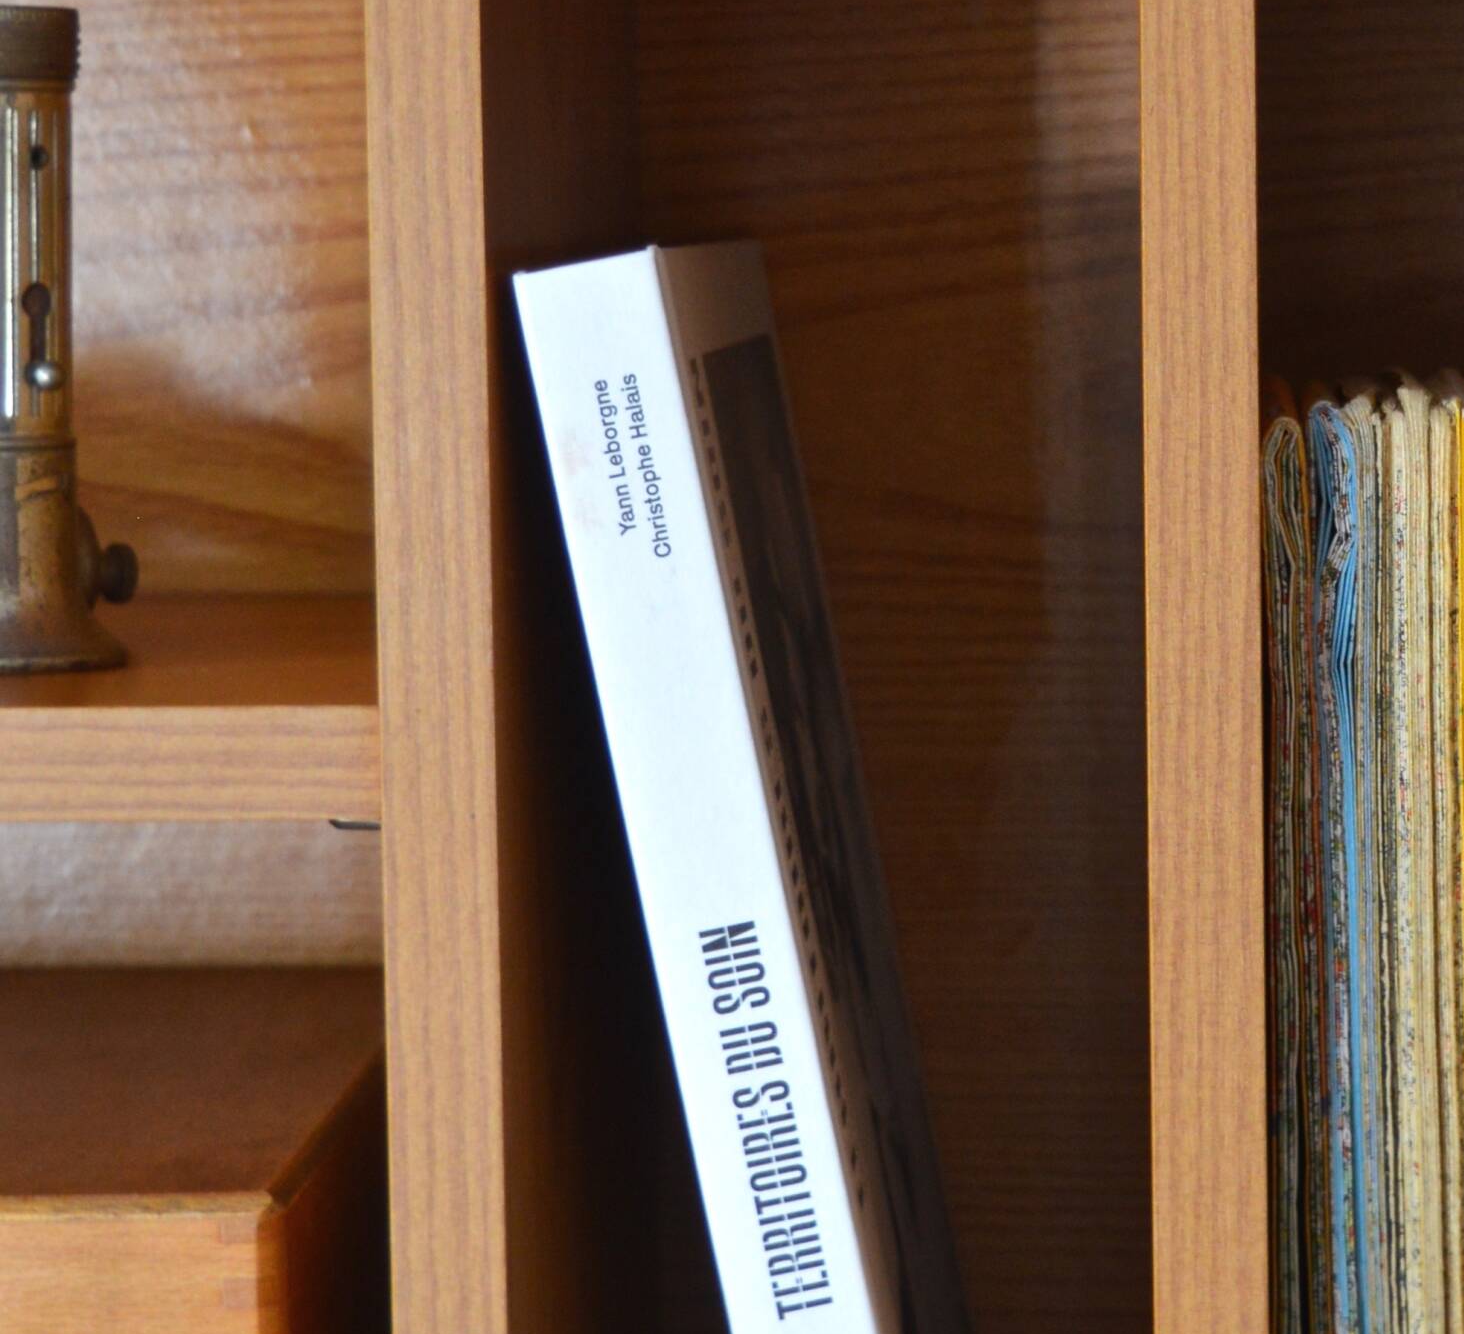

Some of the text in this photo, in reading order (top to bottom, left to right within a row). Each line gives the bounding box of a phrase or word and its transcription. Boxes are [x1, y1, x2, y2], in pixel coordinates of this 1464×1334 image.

[594, 380, 636, 536] Yann Leborgne
[621, 373, 671, 558] Christophe Halais
[699, 921, 771, 1015] SOIN
[719, 1020, 784, 1074] DU
[733, 1079, 833, 1320] TERRITOIRES
